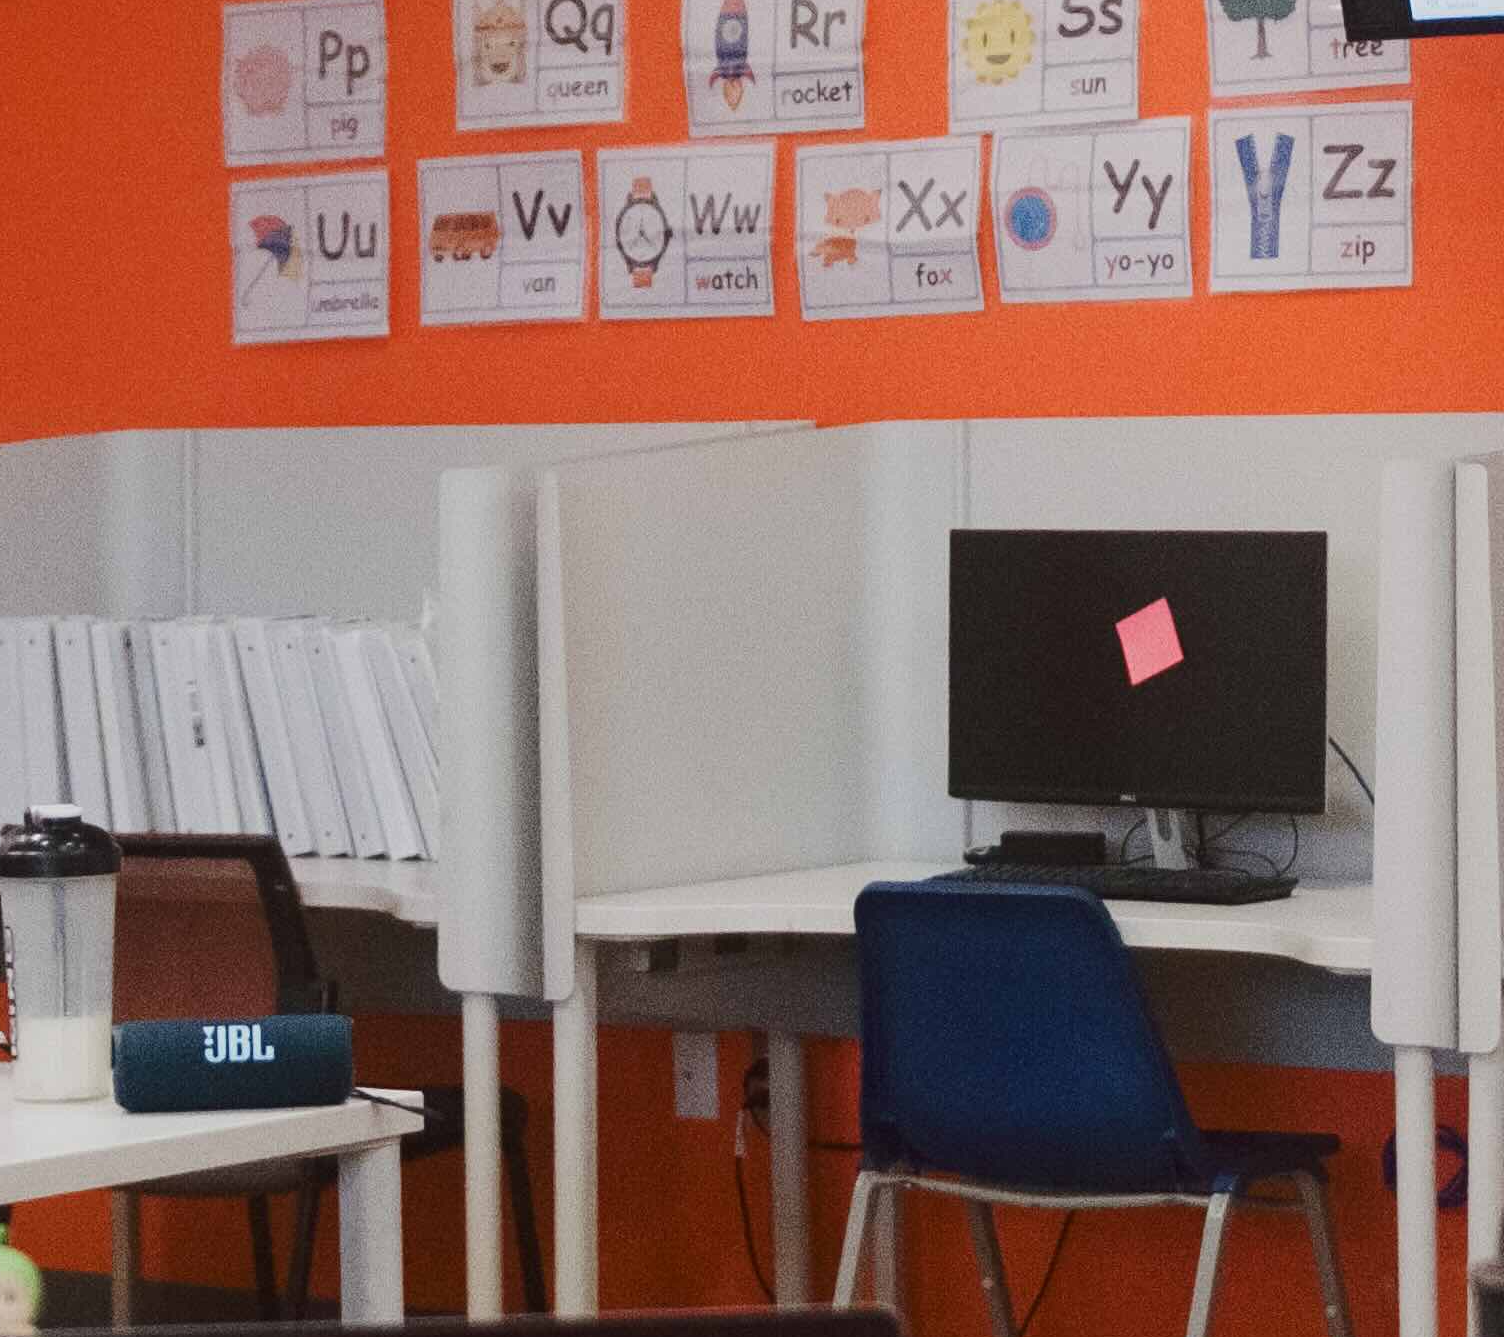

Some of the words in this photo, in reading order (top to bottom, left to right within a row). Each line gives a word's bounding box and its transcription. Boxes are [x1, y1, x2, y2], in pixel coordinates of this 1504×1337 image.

[318, 29, 370, 96] Pp
[1329, 38, 1384, 59] tree
[546, 78, 609, 102] queen
[781, 78, 853, 107] rocket
[1070, 73, 1106, 96] sun
[331, 114, 359, 140] pig
[1322, 143, 1397, 200] Zz
[895, 178, 968, 232] Xx
[1104, 158, 1173, 230] Yy
[513, 189, 572, 242] Vv
[689, 192, 761, 236] Ww
[317, 211, 377, 261] Uu
[1339, 234, 1376, 265] zip
[695, 266, 759, 292] watch
[916, 263, 953, 287] fox
[1104, 249, 1174, 279] yo-yo
[522, 273, 556, 294] van
[310, 291, 380, 314] umbrella
[202, 1024, 274, 1063] JBL
